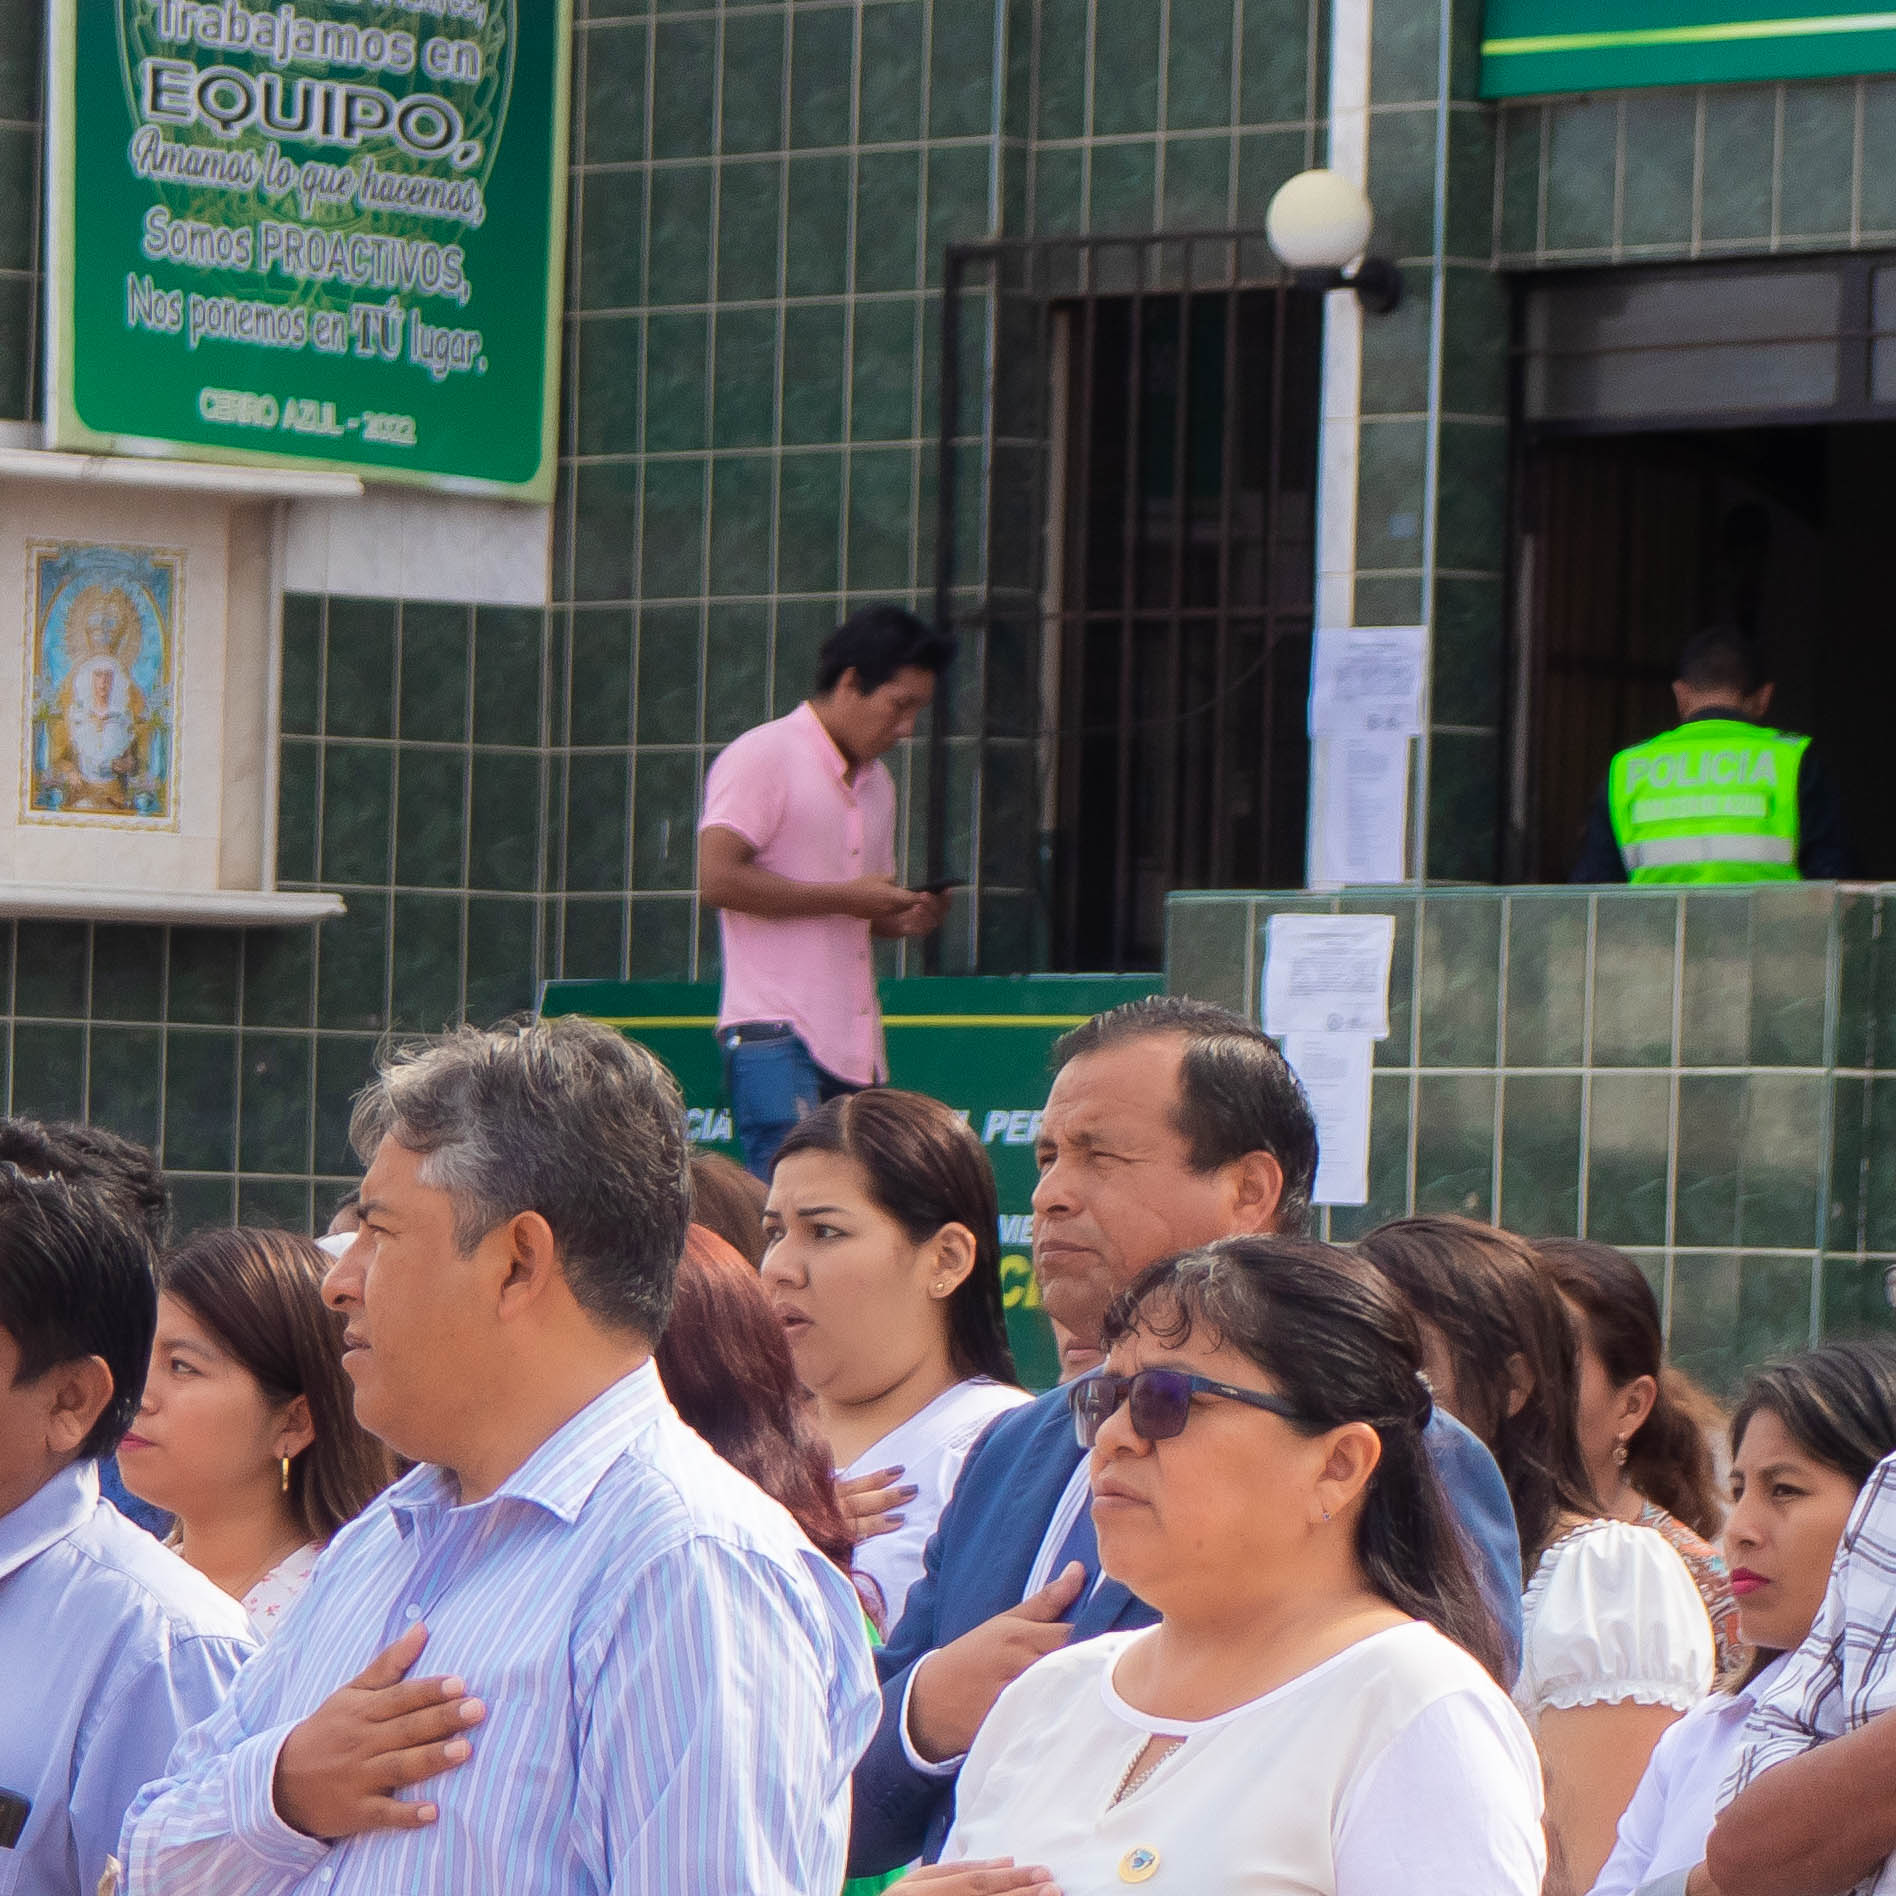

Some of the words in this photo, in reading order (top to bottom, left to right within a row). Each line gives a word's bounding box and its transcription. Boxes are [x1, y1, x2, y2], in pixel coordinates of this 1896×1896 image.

[157, 0, 416, 73] Trabajamos
[423, 37, 482, 84] en
[141, 57, 482, 171] EQUIPO,
[128, 124, 258, 191] Amamos
[260, 141, 298, 197] lo
[298, 161, 357, 219] que
[358, 156, 486, 228] hacemos,
[142, 204, 252, 270] Somos
[257, 219, 470, 306] PROACTIVOS,
[127, 272, 183, 333] Nos
[187, 292, 307, 350] ponemos
[311, 311, 347, 354] en
[409, 307, 489, 380] lugar.
[199, 387, 279, 429] CERRO
[281, 397, 345, 436] AZUL
[1626, 749, 1777, 794] POLICIA
